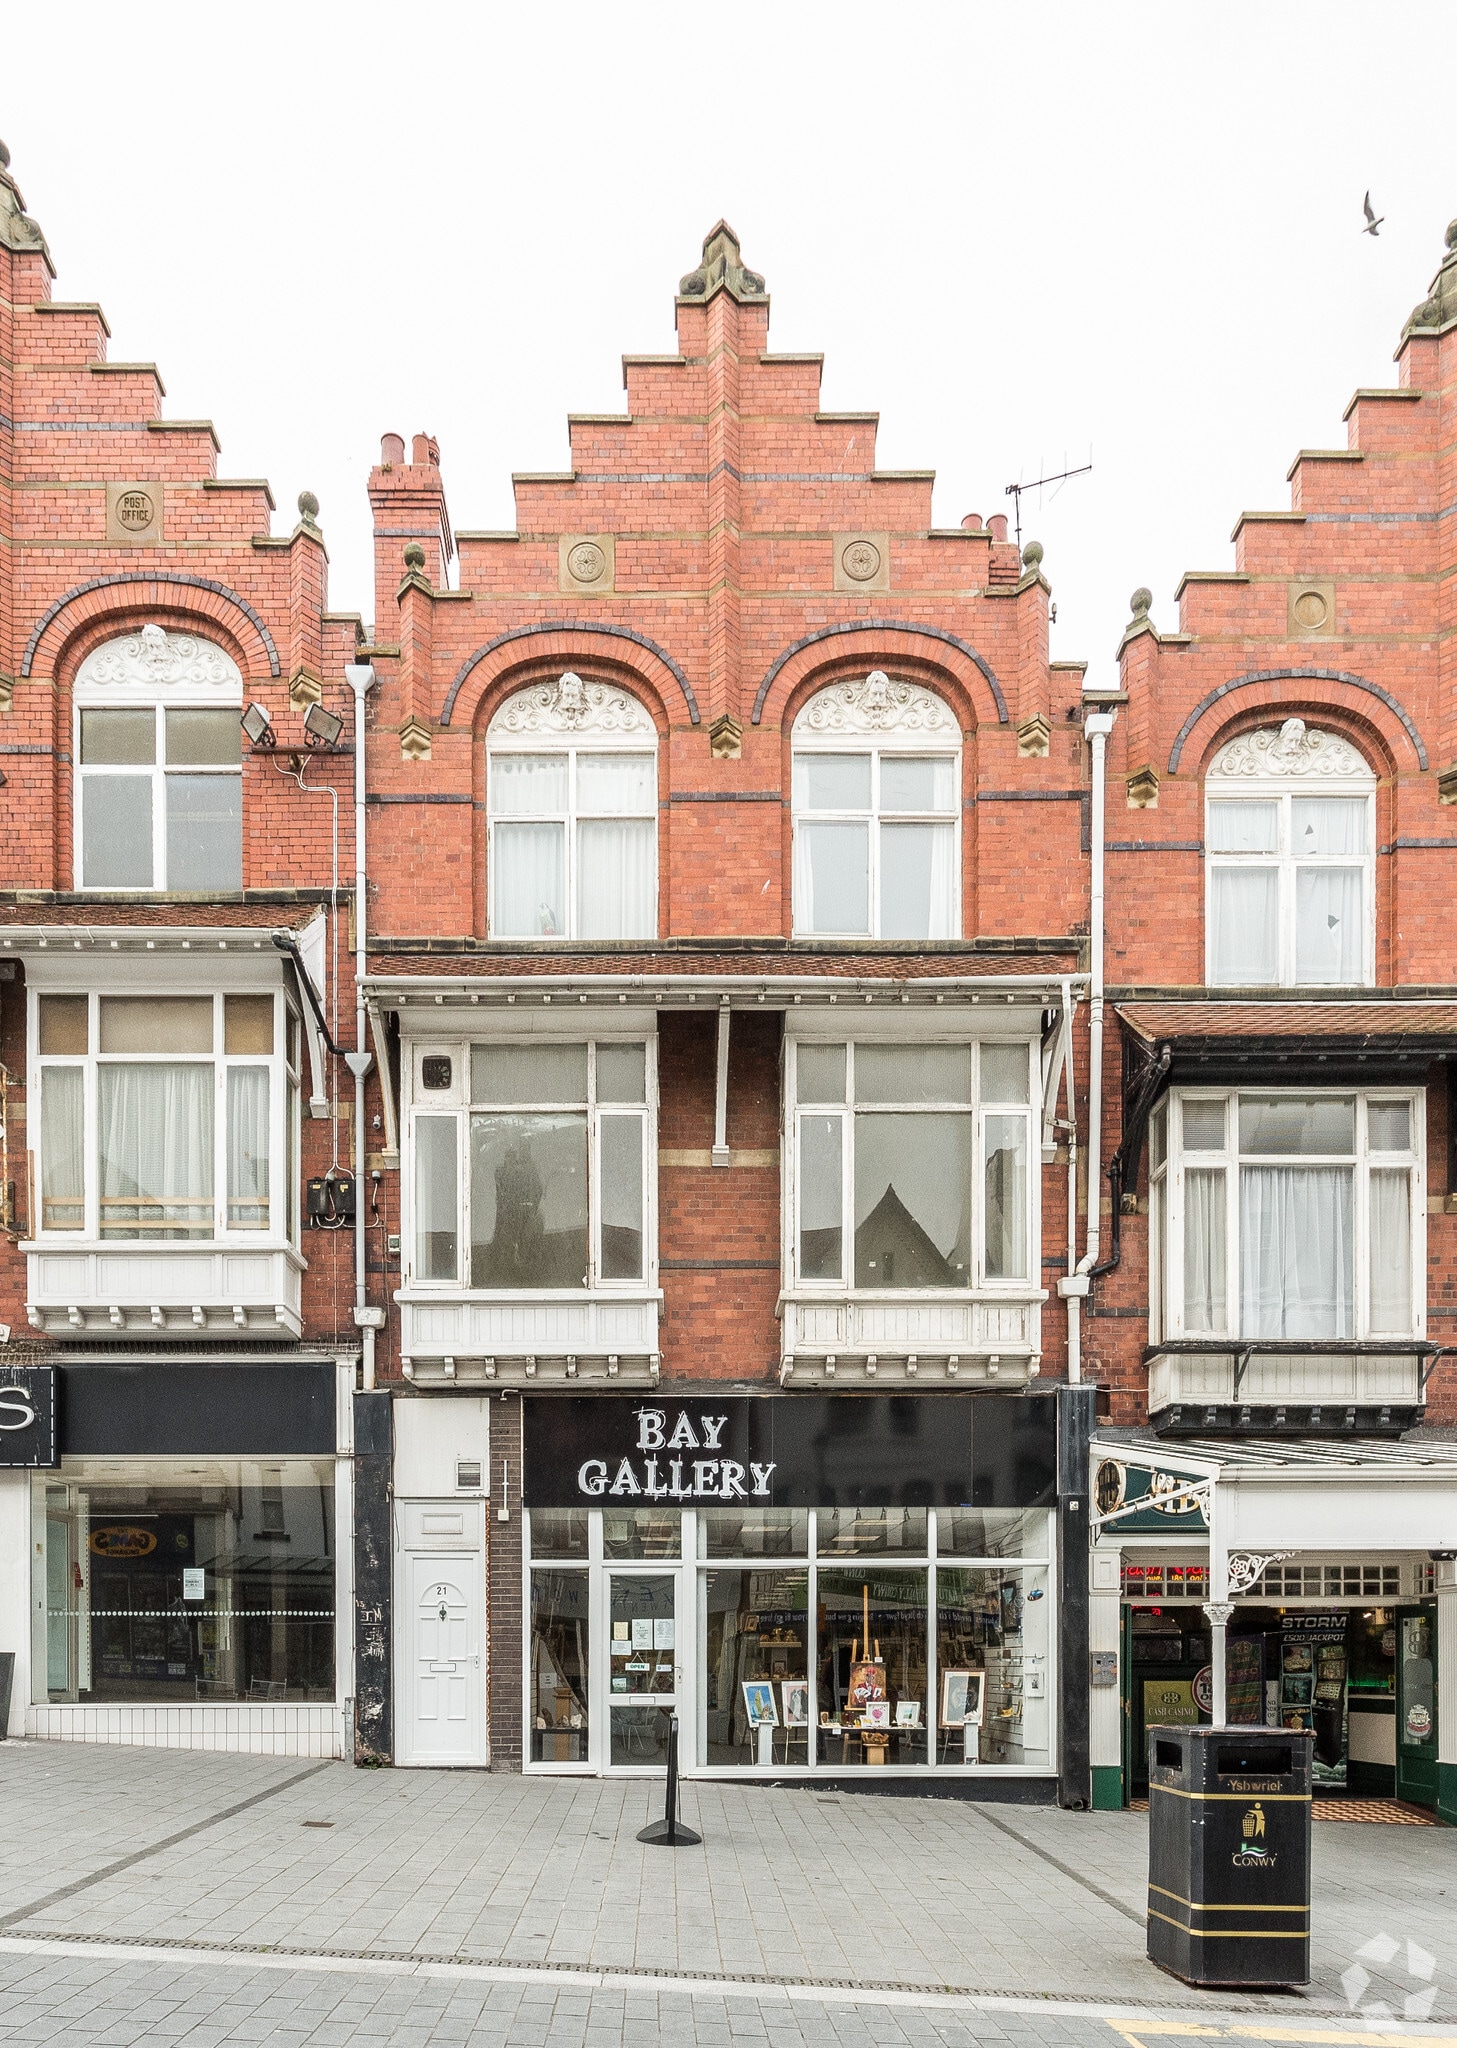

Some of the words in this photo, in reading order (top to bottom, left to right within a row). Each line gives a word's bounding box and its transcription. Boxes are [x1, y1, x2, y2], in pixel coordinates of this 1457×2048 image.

[124, 497, 146, 508] POST
[121, 510, 149, 521] OFFICE
[632, 1406, 728, 1453] BAY
[578, 1454, 777, 1501] GALLERY
[436, 1586, 447, 1595] 21
[1281, 1616, 1347, 1628] STORM
[1308, 1633, 1346, 1642] JACKPOT
[1148, 1707, 1167, 1716] CASH
[1168, 1707, 1194, 1716] CASINO
[1229, 1780, 1281, 1791] Ysbwriel
